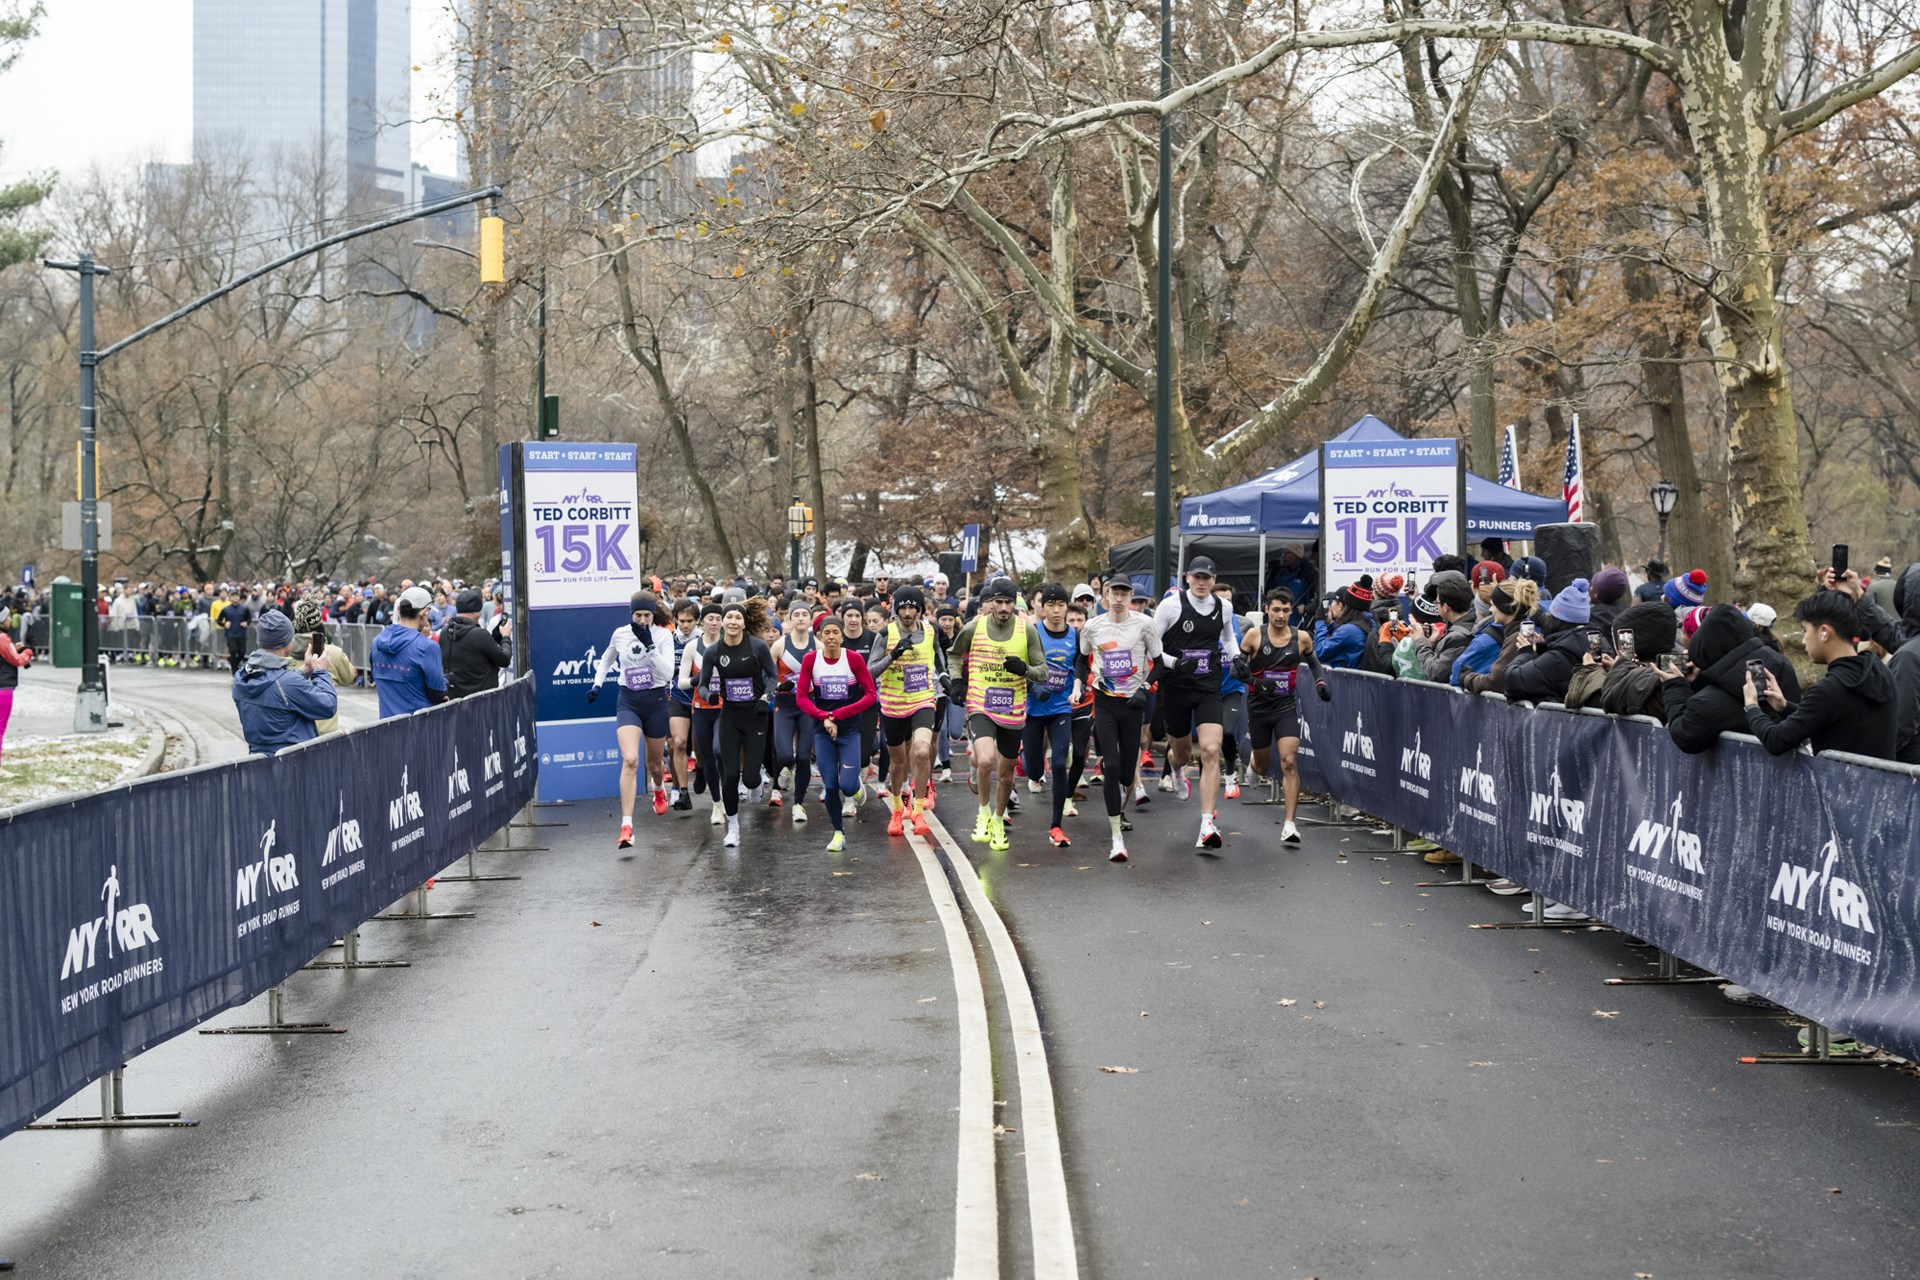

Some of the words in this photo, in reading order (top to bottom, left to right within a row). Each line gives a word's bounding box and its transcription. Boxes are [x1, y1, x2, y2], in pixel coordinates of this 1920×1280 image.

[529, 451, 560, 460] START
[568, 452, 596, 460] START
[604, 452, 632, 460] START
[1330, 450, 1363, 458] START
[1373, 449, 1406, 457] START
[1417, 447, 1450, 456] START
[1334, 502, 1367, 514] TED
[1373, 501, 1449, 514] CORBITT
[533, 508, 563, 521] TED
[568, 507, 631, 520] CORBITT
[1480, 521, 1531, 531] RUNNERS
[1335, 517, 1447, 563] 15K
[535, 524, 632, 573] 15K
[962, 536, 975, 560] AA
[1110, 660, 1131, 669] 5009
[632, 674, 651, 684] 6382
[911, 672, 927, 682] 5504
[732, 687, 752, 695] 3022
[827, 684, 847, 692] 3552
[992, 696, 1012, 705] 5503
[1638, 868, 1656, 885] YORK
[1656, 875, 1678, 891] ROAD
[262, 909, 277, 926] ROAD
[1767, 915, 1785, 933] NEW
[1787, 921, 1807, 941] YORK
[1809, 930, 1831, 950] ROAD
[1833, 939, 1872, 965] RUNNERS
[61, 993, 78, 1015] NEW
[80, 982, 99, 1005] YORK
[102, 973, 122, 995] ROAD
[124, 957, 163, 984] RUNNERS
